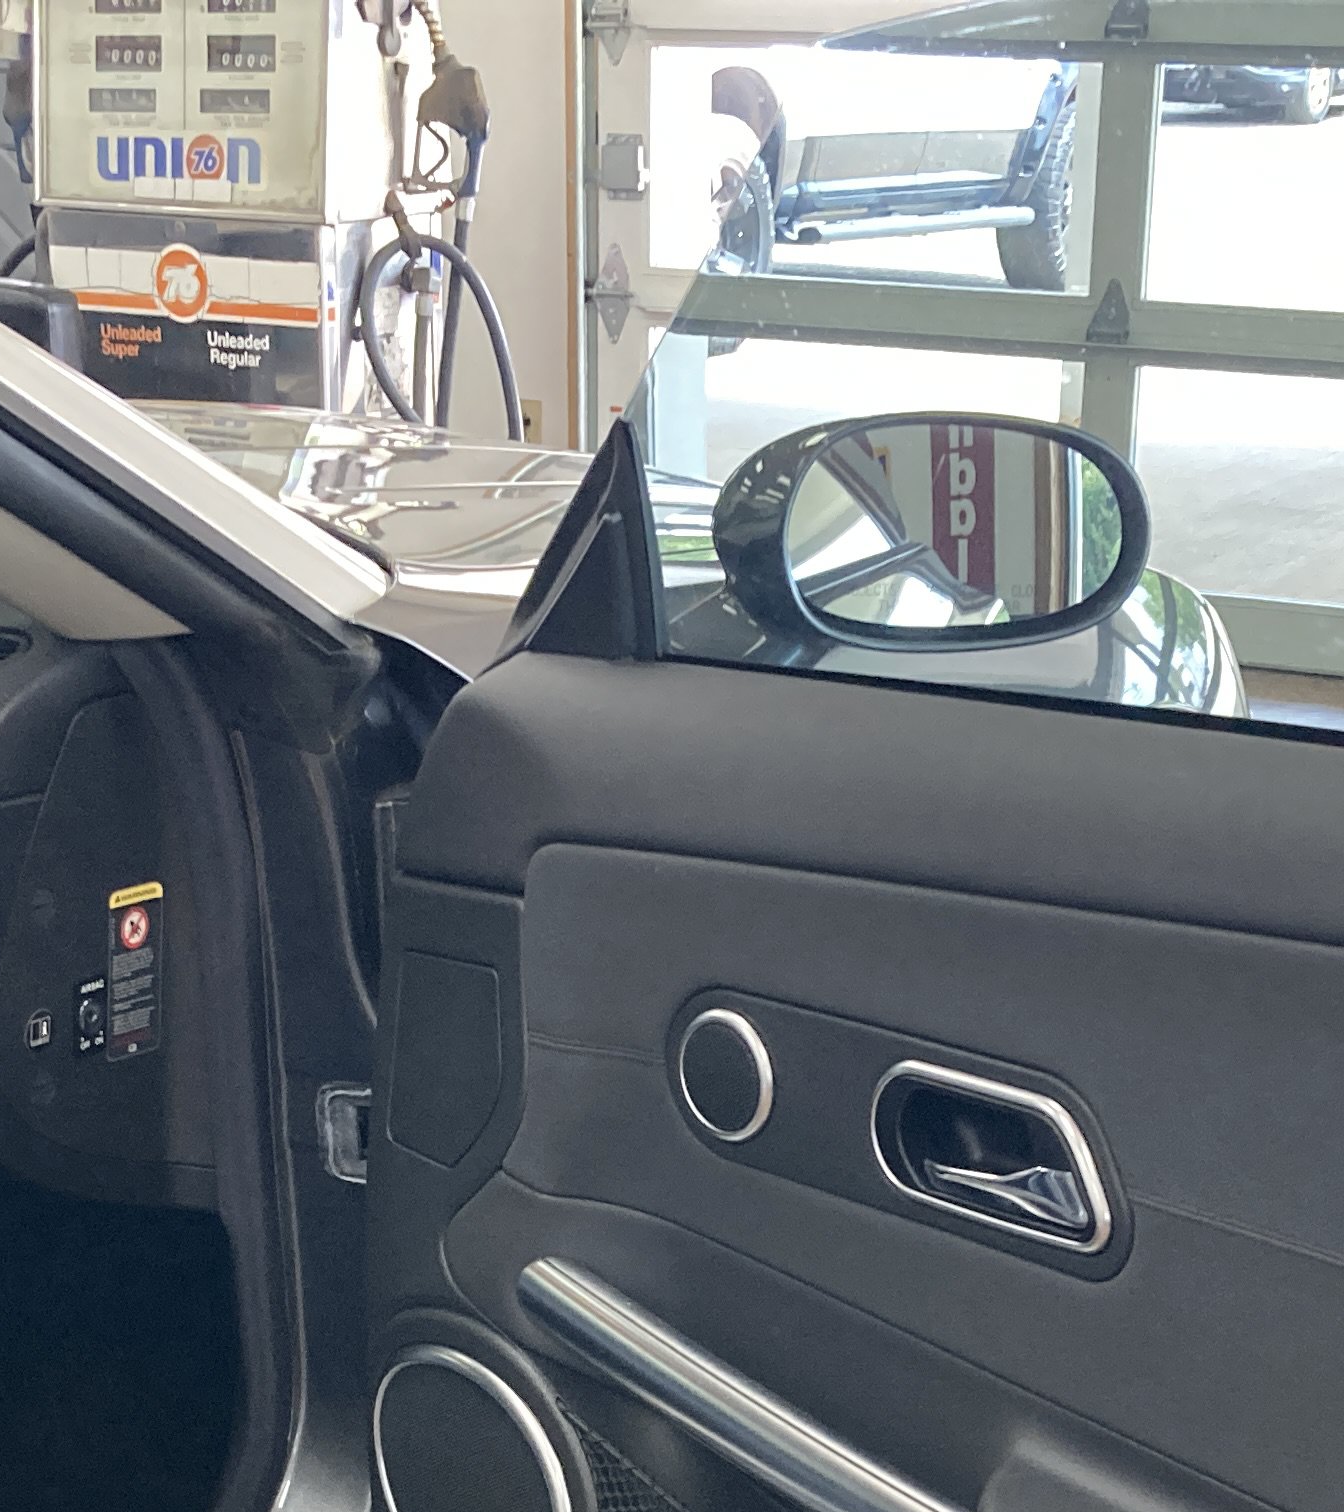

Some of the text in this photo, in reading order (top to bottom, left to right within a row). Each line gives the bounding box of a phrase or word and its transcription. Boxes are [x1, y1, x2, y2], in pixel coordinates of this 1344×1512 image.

[191, 145, 219, 175] 76
[162, 264, 201, 304] 76
[100, 323, 161, 342] Unleaded
[207, 330, 269, 351] Unleaded
[102, 340, 140, 359] Super
[209, 349, 261, 369] Regular
